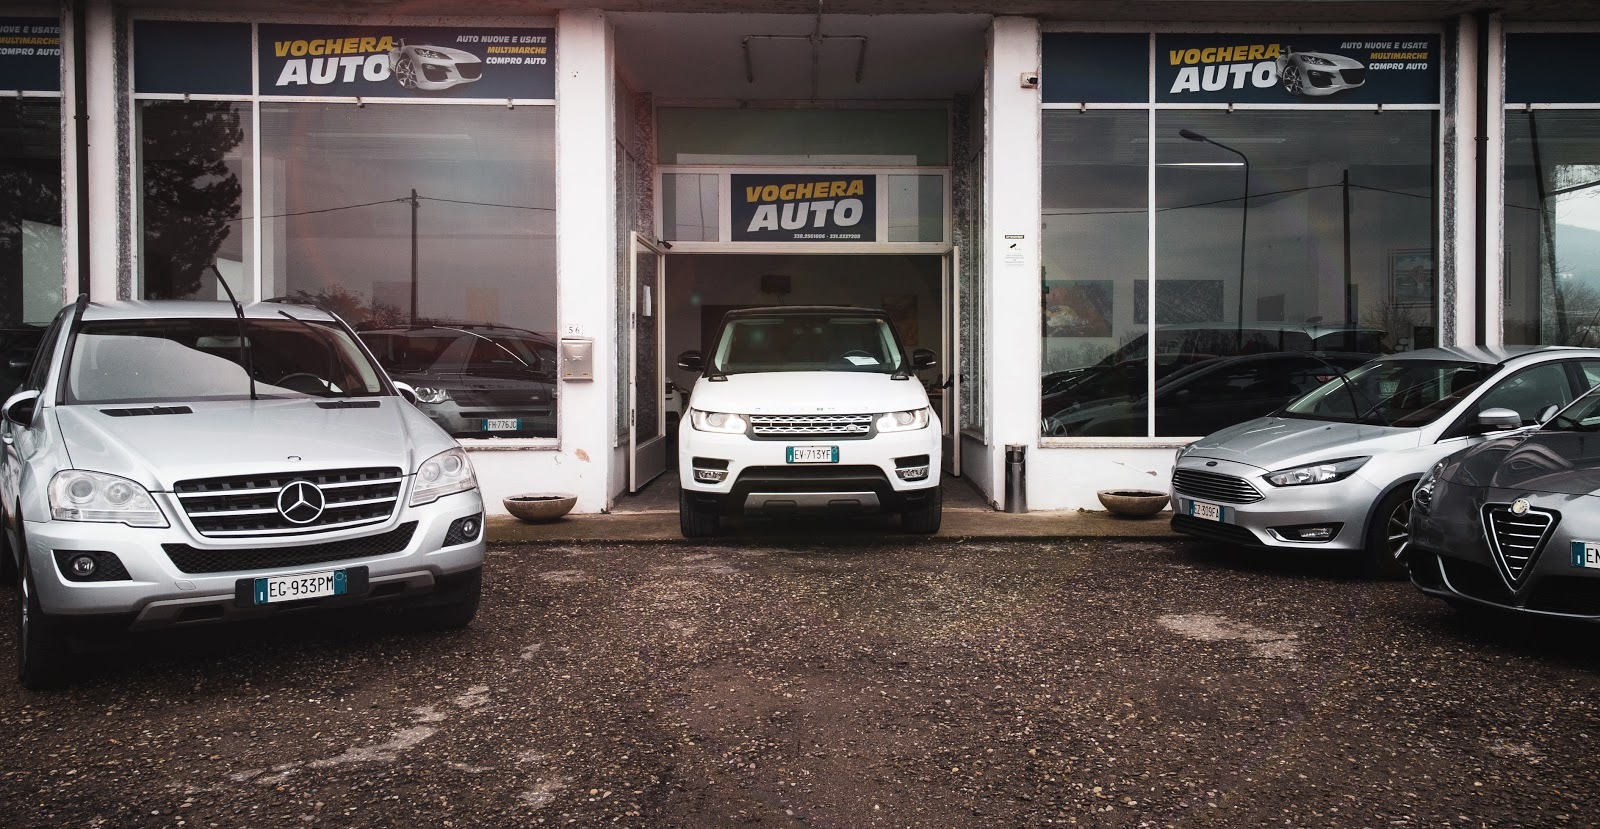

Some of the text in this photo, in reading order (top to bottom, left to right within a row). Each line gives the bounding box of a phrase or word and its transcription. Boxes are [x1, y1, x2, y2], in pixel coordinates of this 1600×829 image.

[32, 26, 60, 34] USATE
[456, 35, 479, 43] AUTO
[481, 35, 510, 43] NUOVE
[520, 36, 547, 44] USATE
[275, 36, 394, 57] VOGHERA
[487, 46, 547, 54] MULTIMARCHE
[36, 48, 60, 56] AUTO
[1169, 43, 1281, 66] VOGHERA
[1370, 52, 1429, 60] MULTIMARCHE
[486, 56, 547, 65] COMPRO AUTO
[275, 54, 392, 86] AUTO
[1369, 62, 1428, 70] COMPRO AUTO
[1169, 61, 1279, 94] AUTO
[746, 179, 864, 203] VOGHERA
[746, 198, 863, 232] AUTO
